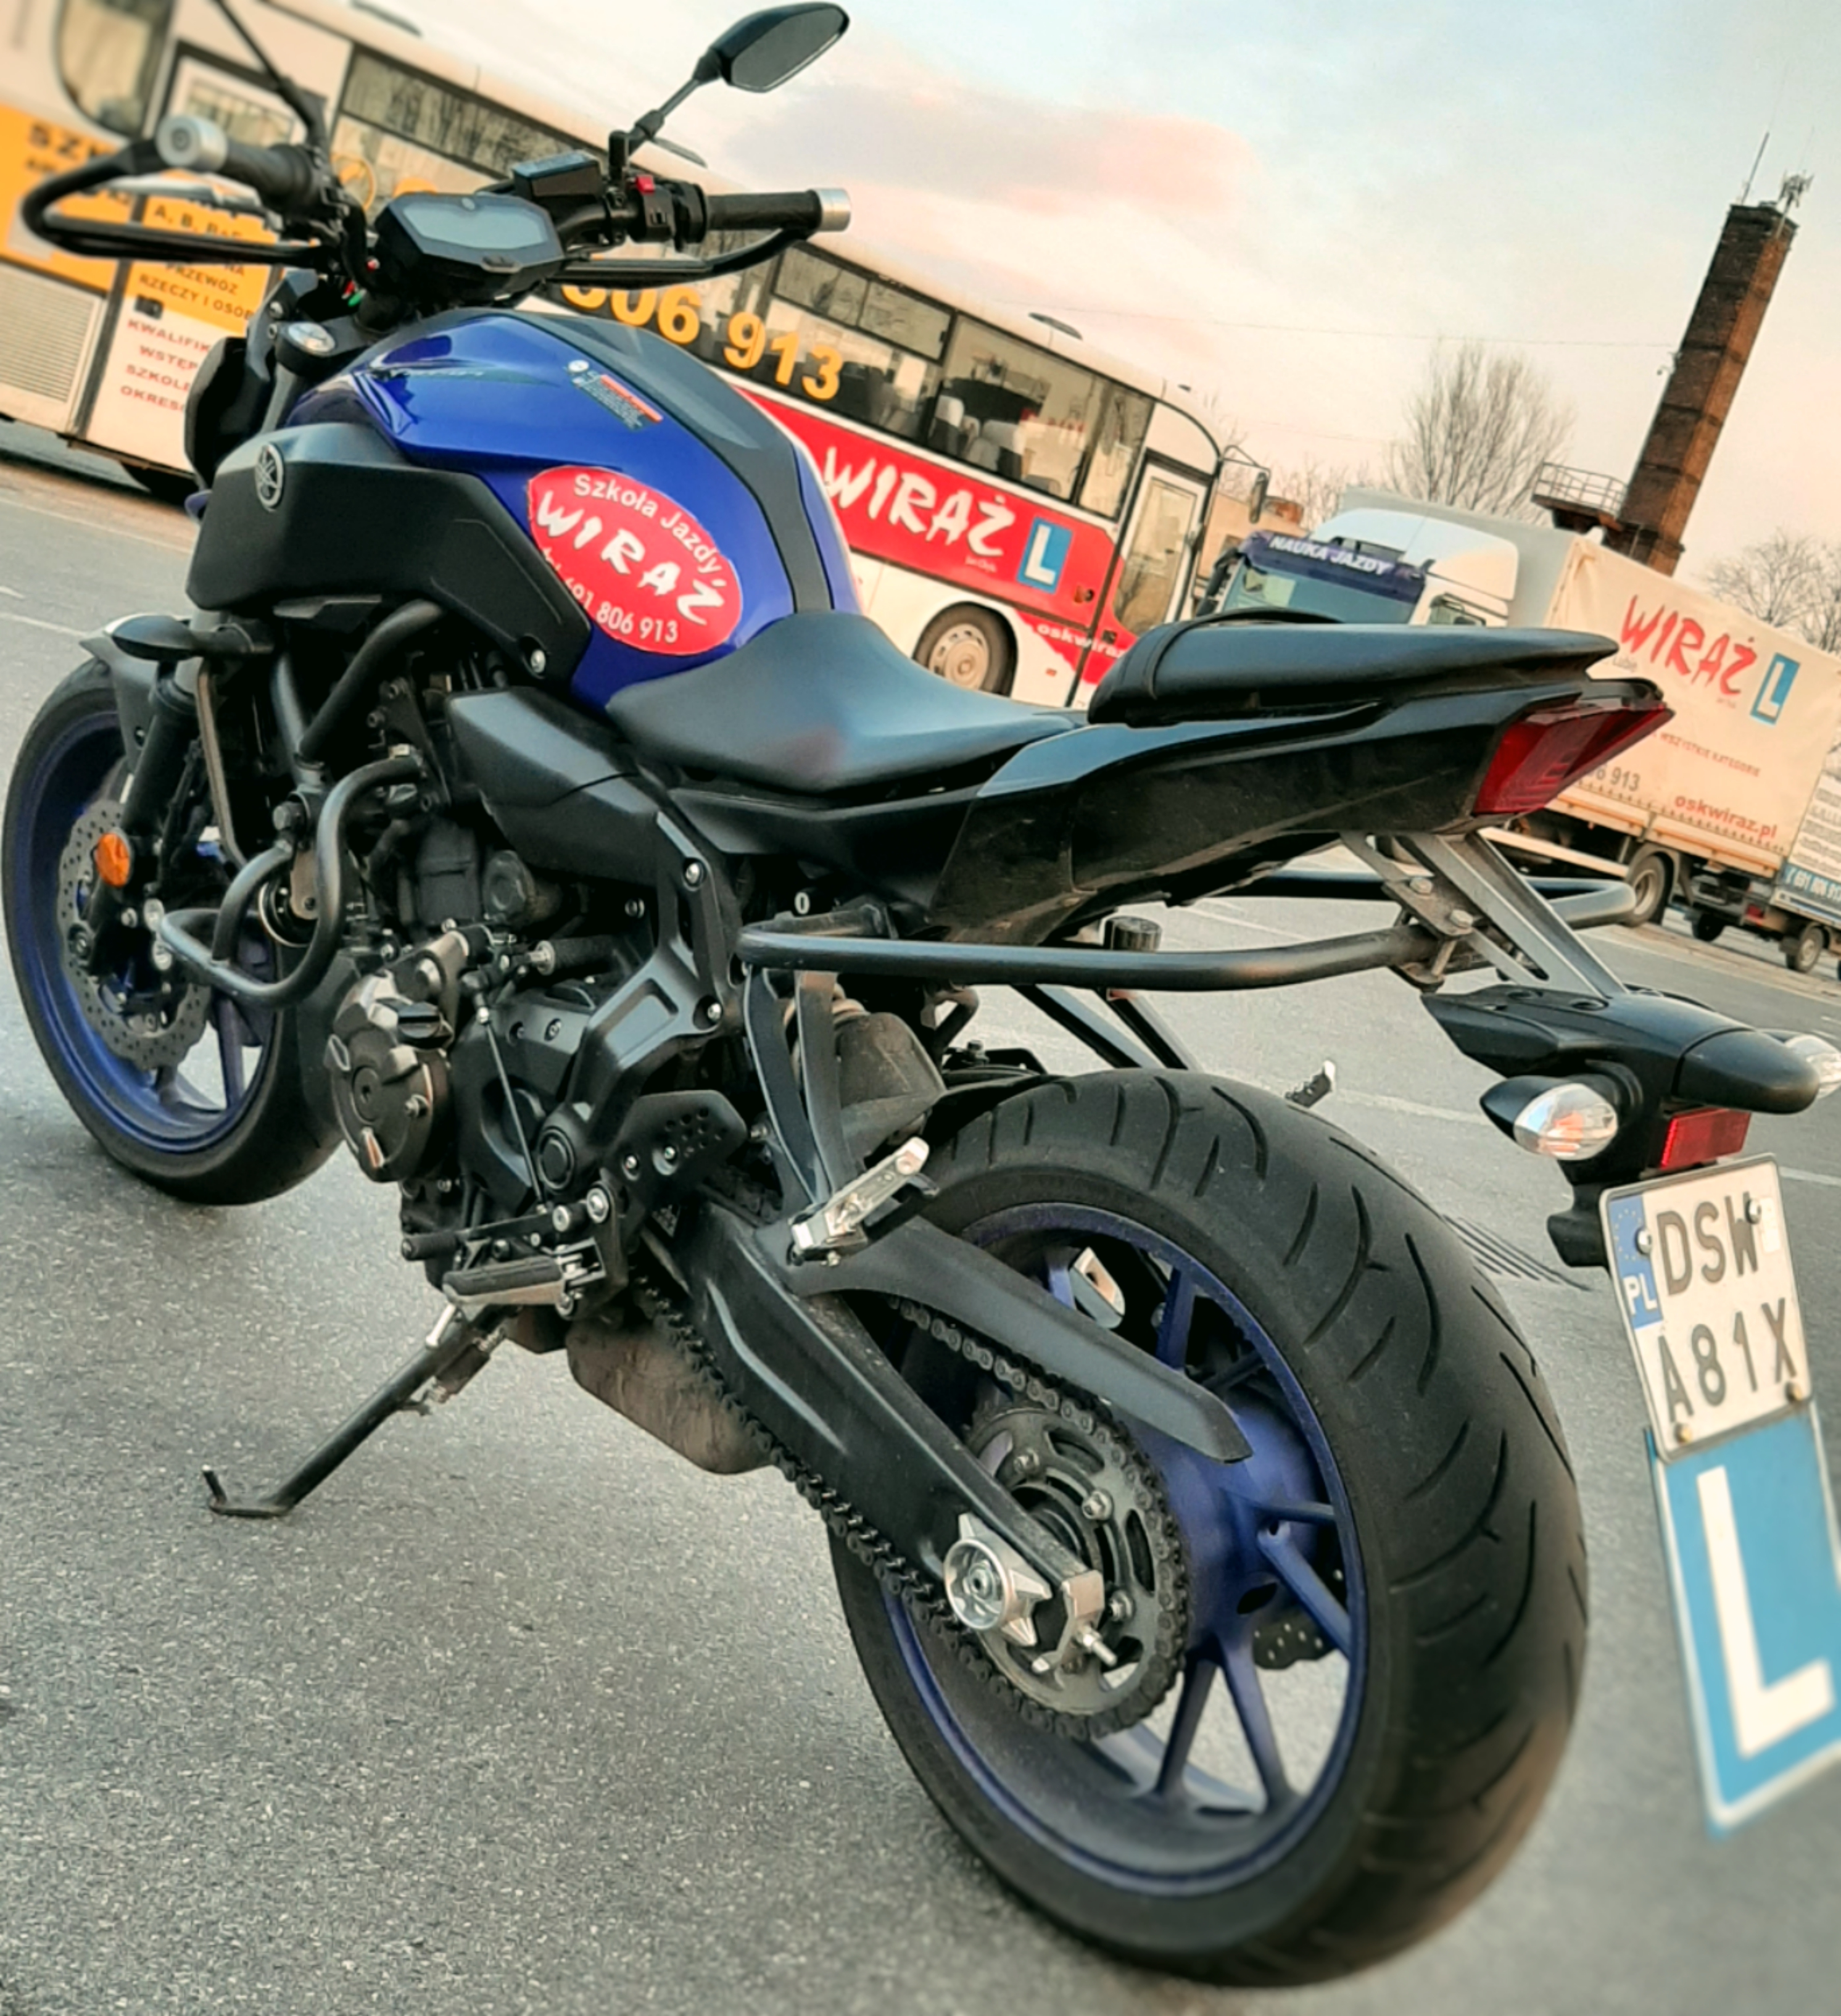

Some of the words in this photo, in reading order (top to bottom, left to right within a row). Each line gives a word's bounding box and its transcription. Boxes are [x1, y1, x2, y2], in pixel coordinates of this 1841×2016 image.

[139, 274, 199, 302] RZECZY
[723, 312, 843, 400] 913
[573, 473, 659, 518] Szkoła
[660, 512, 722, 574] Jazdy
[822, 446, 1016, 557] WIRAŻ
[536, 490, 727, 626] WIRAŻ
[1024, 523, 1056, 585] L
[1268, 535, 1328, 562] NAUKA
[1330, 552, 1394, 576] JAZDY
[596, 600, 634, 635] 806
[639, 617, 679, 644] 913
[1620, 594, 1757, 696] WIRAŻ
[1756, 660, 1785, 720] L
[1610, 766, 1640, 792] 913
[1674, 795, 1777, 839] oskwiraz.pl
[1656, 1191, 1758, 1296] DSW
[1621, 1272, 1658, 1315] PL
[1657, 1296, 1798, 1424] A81X
[1695, 1464, 1835, 1760] L
